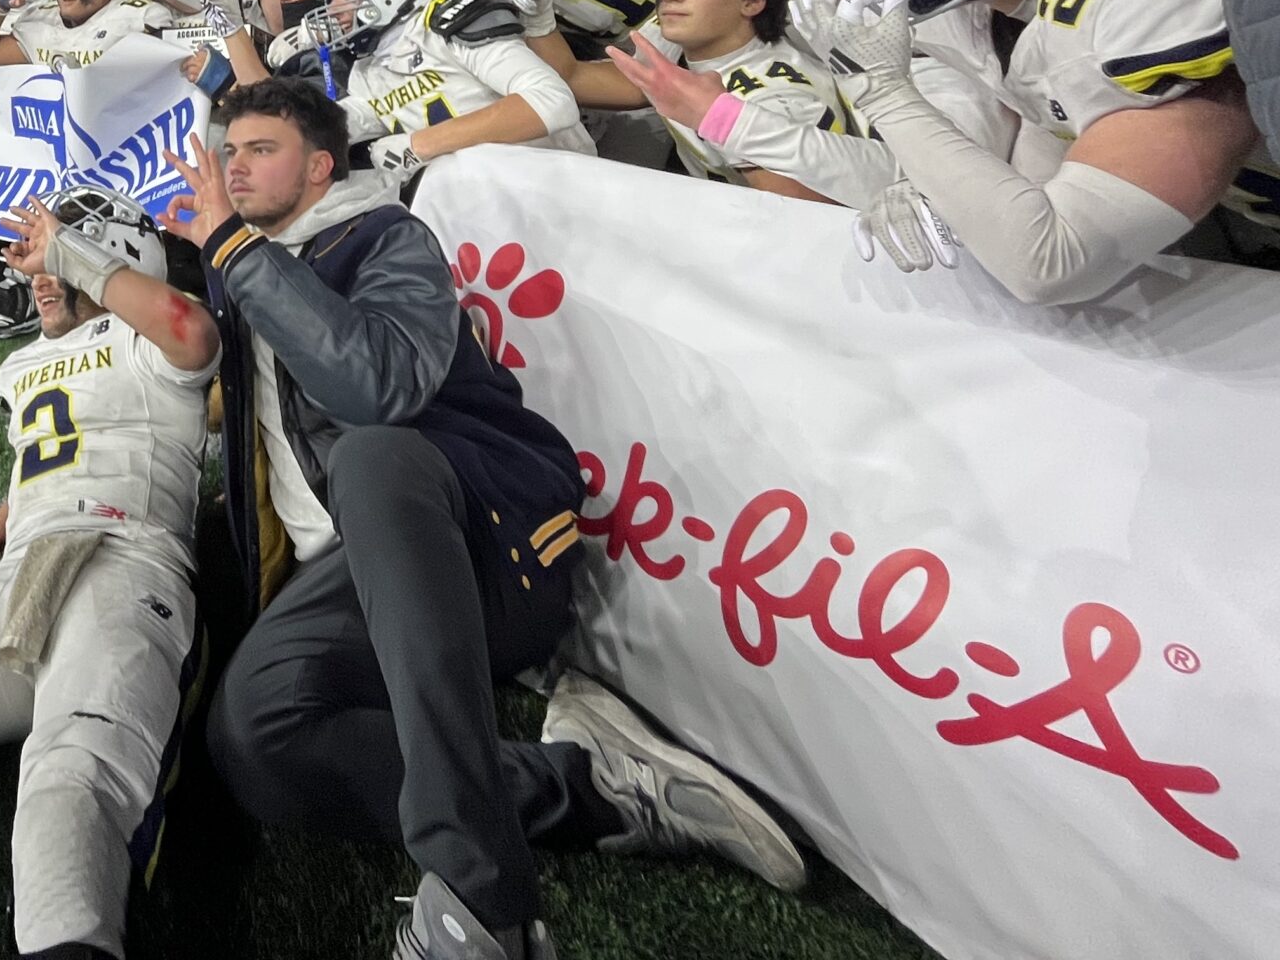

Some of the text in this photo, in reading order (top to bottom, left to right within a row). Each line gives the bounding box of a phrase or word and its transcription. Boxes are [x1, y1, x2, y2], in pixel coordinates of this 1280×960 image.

[177, 30, 206, 38] AGGANIS
[726, 61, 812, 96] 44
[14, 105, 61, 137] MIAA
[152, 180, 187, 200] Leaders
[579, 441, 1239, 861] ck-fil-A
